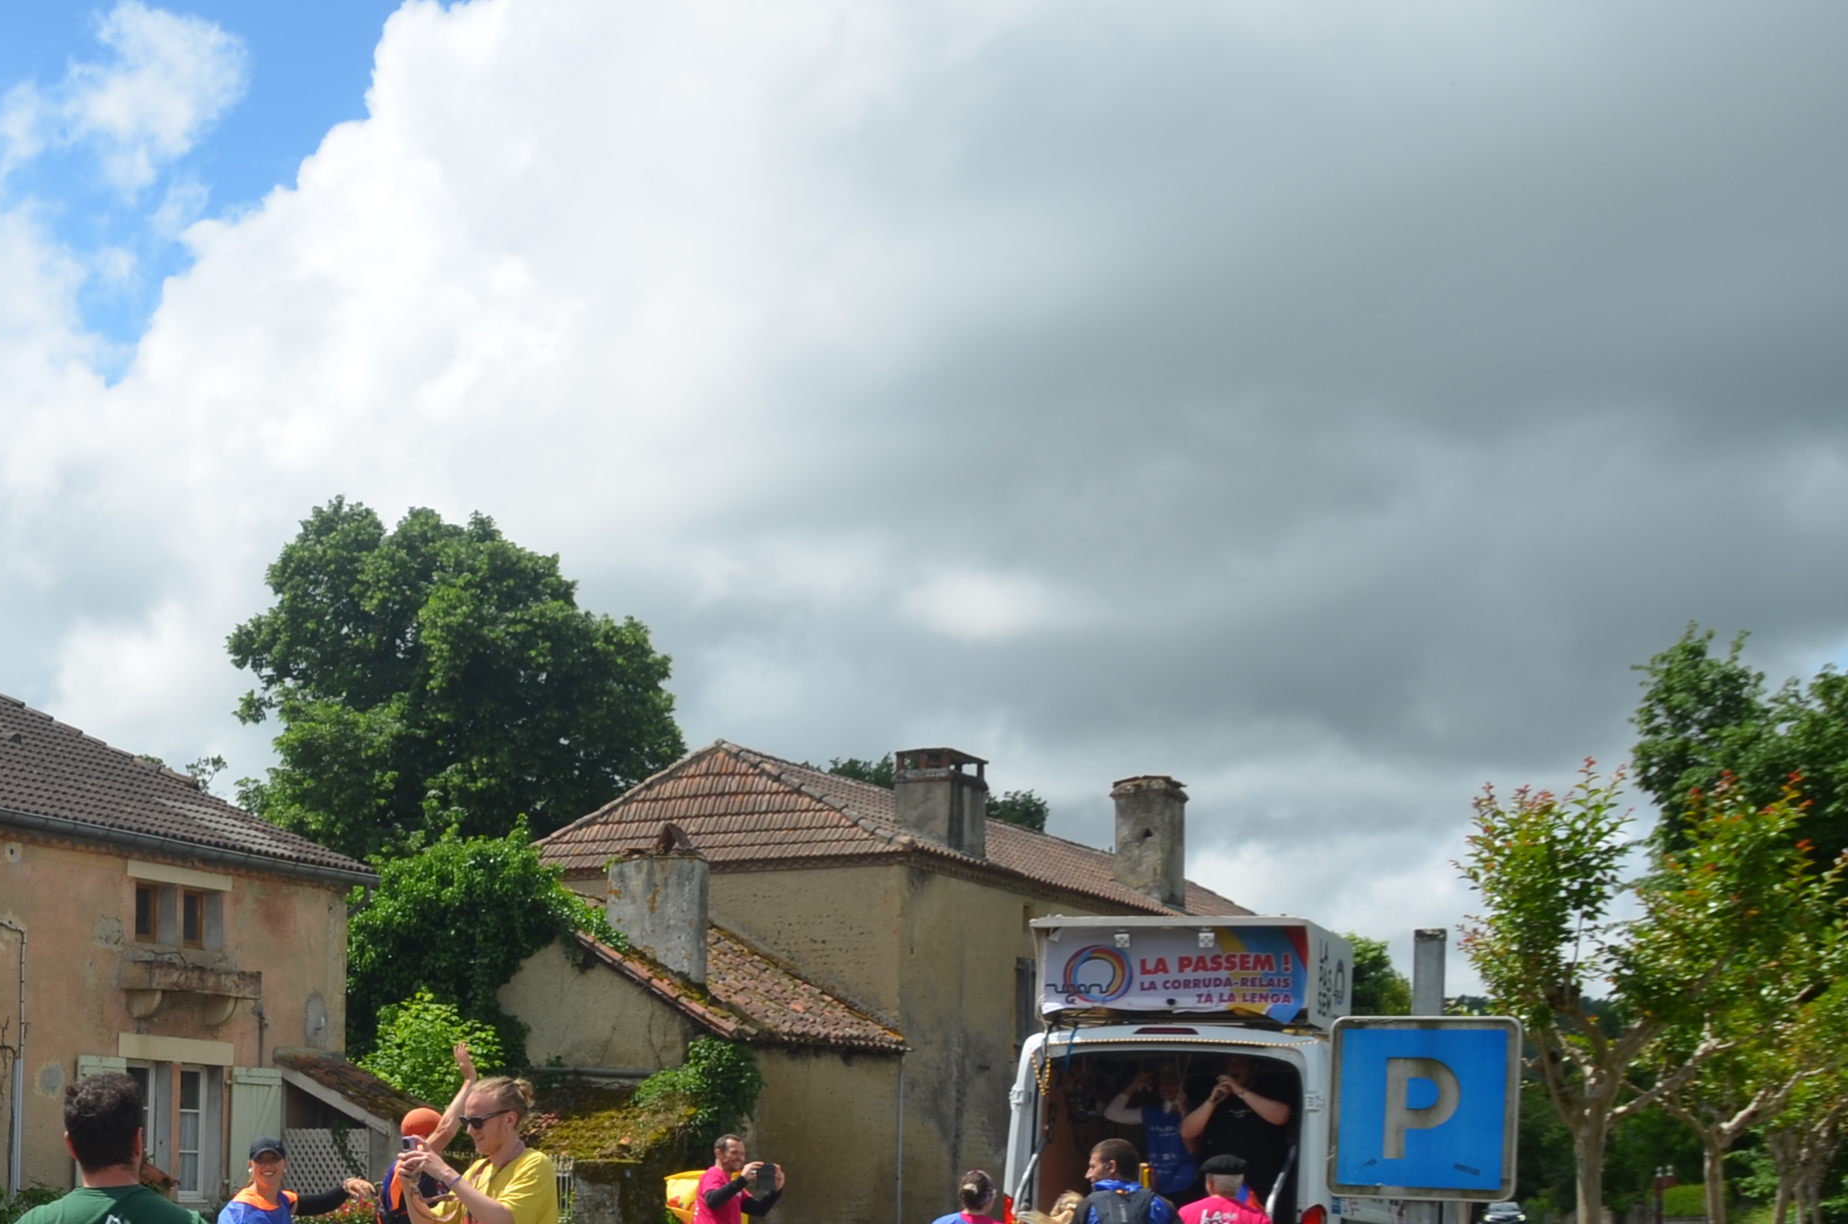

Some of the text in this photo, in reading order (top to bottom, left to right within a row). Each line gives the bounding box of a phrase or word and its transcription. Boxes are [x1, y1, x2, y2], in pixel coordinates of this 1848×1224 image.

[1139, 953, 1292, 976] LA PASSEM !
[1139, 977, 1291, 992] LA CORRUDA-RELAIS
[1219, 993, 1237, 1003] LA
[1242, 993, 1292, 1004] LENGA
[1383, 1057, 1461, 1159] P
[1200, 1209, 1223, 1222] LA
